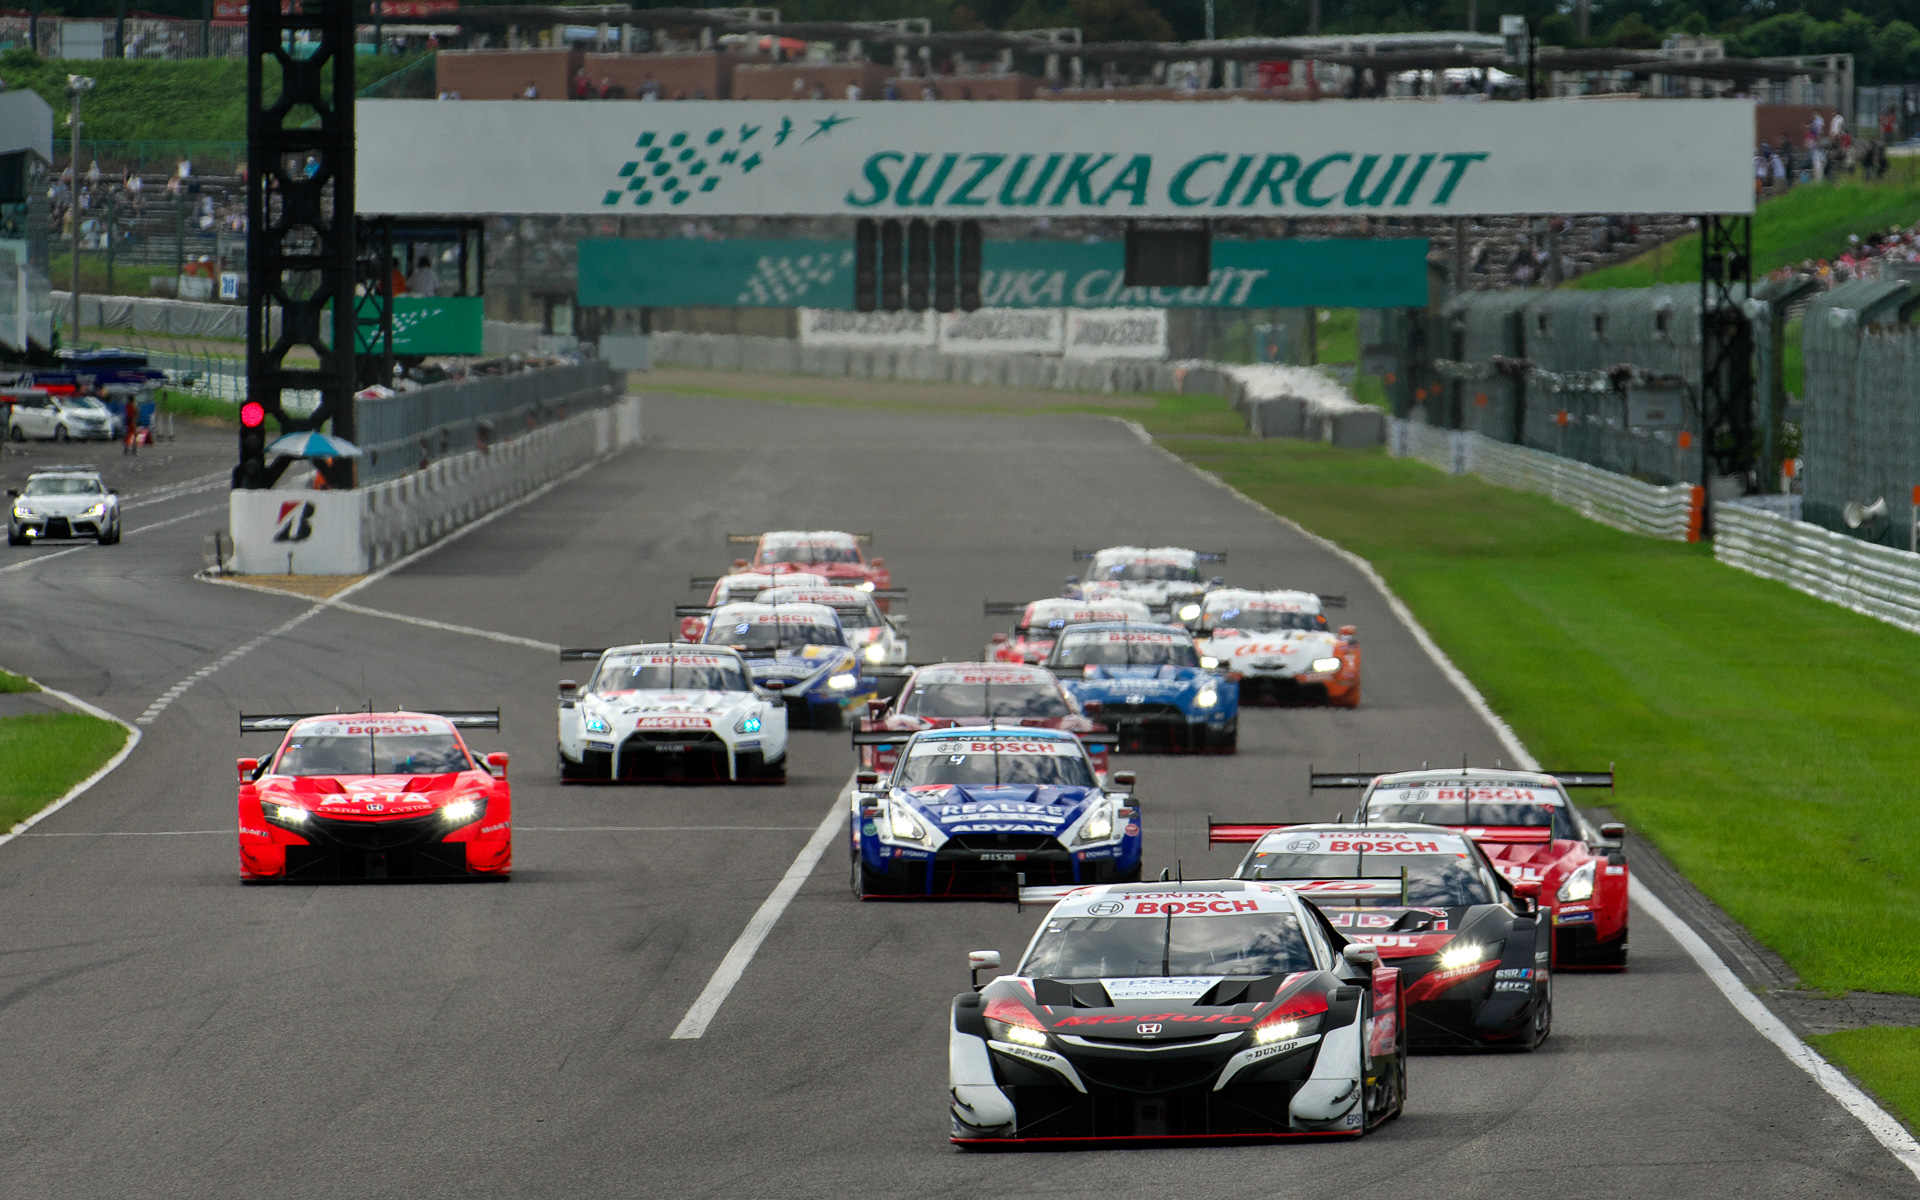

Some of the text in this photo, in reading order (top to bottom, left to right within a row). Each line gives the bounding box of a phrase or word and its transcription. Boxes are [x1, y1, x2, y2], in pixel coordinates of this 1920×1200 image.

[846, 150, 1491, 207] SUZUKA CIRCUIT
[651, 656, 719, 665] BOSCH
[639, 718, 708, 727] MOTUL
[347, 725, 429, 735] BOSCH
[970, 742, 1056, 753] BOSCH
[950, 755, 965, 765] 4
[319, 792, 430, 805] ARTA
[1438, 788, 1535, 801] BOSCH
[941, 803, 1063, 816] REALIZE
[949, 824, 1057, 832] ADVAN
[1318, 832, 1410, 840] HONDA
[1329, 841, 1439, 853] BOSCH
[1122, 892, 1227, 900] HONDA
[1134, 899, 1260, 915] BOSCH
[1442, 965, 1481, 980] DUNLOP
[1109, 979, 1212, 987] EPSON
[1114, 989, 1201, 997] KENWOOD
[1052, 1012, 1254, 1028] Modulo
[1014, 1047, 1057, 1063] DUNLOP
[1253, 1041, 1299, 1058] DUNLOP
